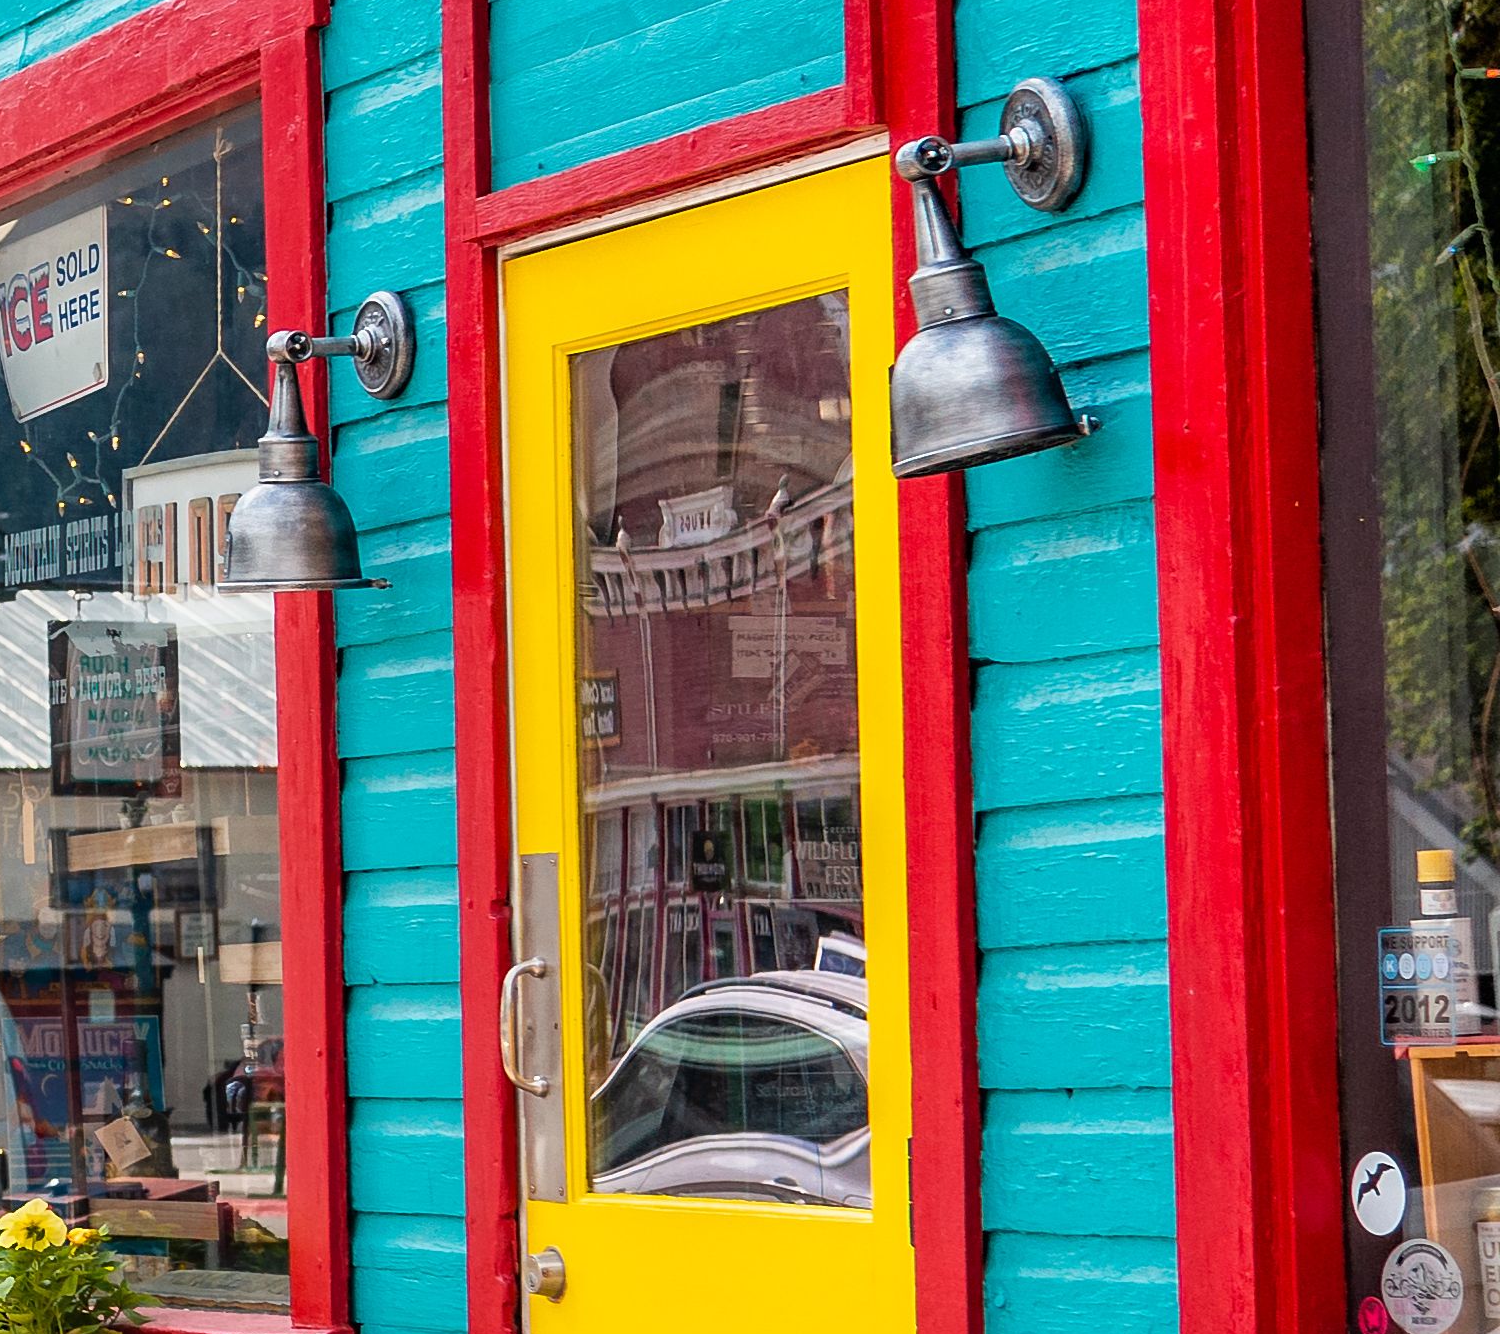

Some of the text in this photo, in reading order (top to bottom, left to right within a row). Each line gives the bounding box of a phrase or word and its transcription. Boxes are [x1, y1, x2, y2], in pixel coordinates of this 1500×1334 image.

[56, 243, 100, 287] SOLD
[58, 288, 100, 333] HERE
[66, 515, 109, 576] SPIRITS
[79, 672, 123, 705] LIQUOR
[135, 666, 167, 696] BEER
[1400, 935, 1449, 949] SUPPORT
[1384, 994, 1451, 1024] 2012
